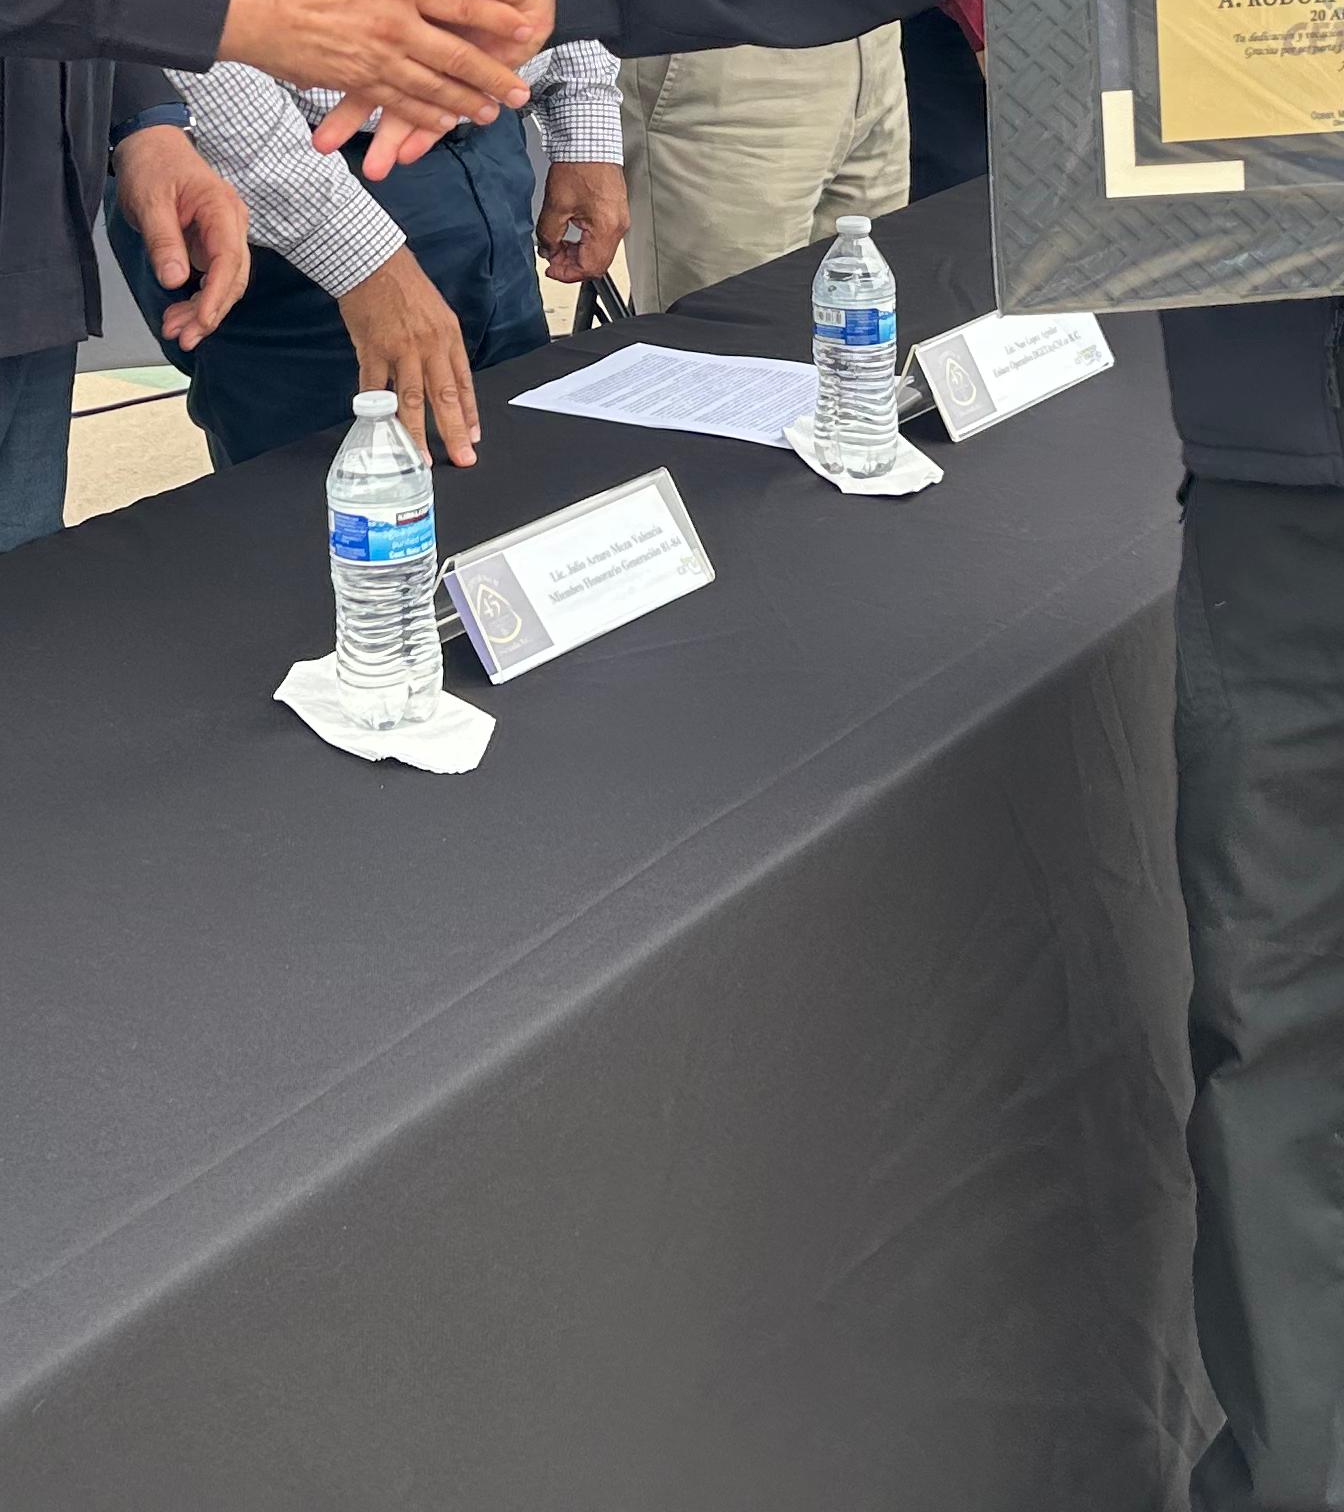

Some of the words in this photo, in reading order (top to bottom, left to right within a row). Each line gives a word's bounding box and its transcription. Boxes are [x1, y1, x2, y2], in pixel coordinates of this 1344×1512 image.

[1310, 10, 1326, 22] 20
[548, 583, 584, 605] Miembro
[582, 564, 622, 590] Honorario
[621, 546, 662, 571] Generación
[661, 536, 683, 554] 81-84
[549, 569, 567, 583] Lic.
[566, 560, 587, 576] Julio
[586, 551, 612, 567] Arturo
[610, 541, 633, 557] Meza
[631, 525, 664, 545] Valencia
